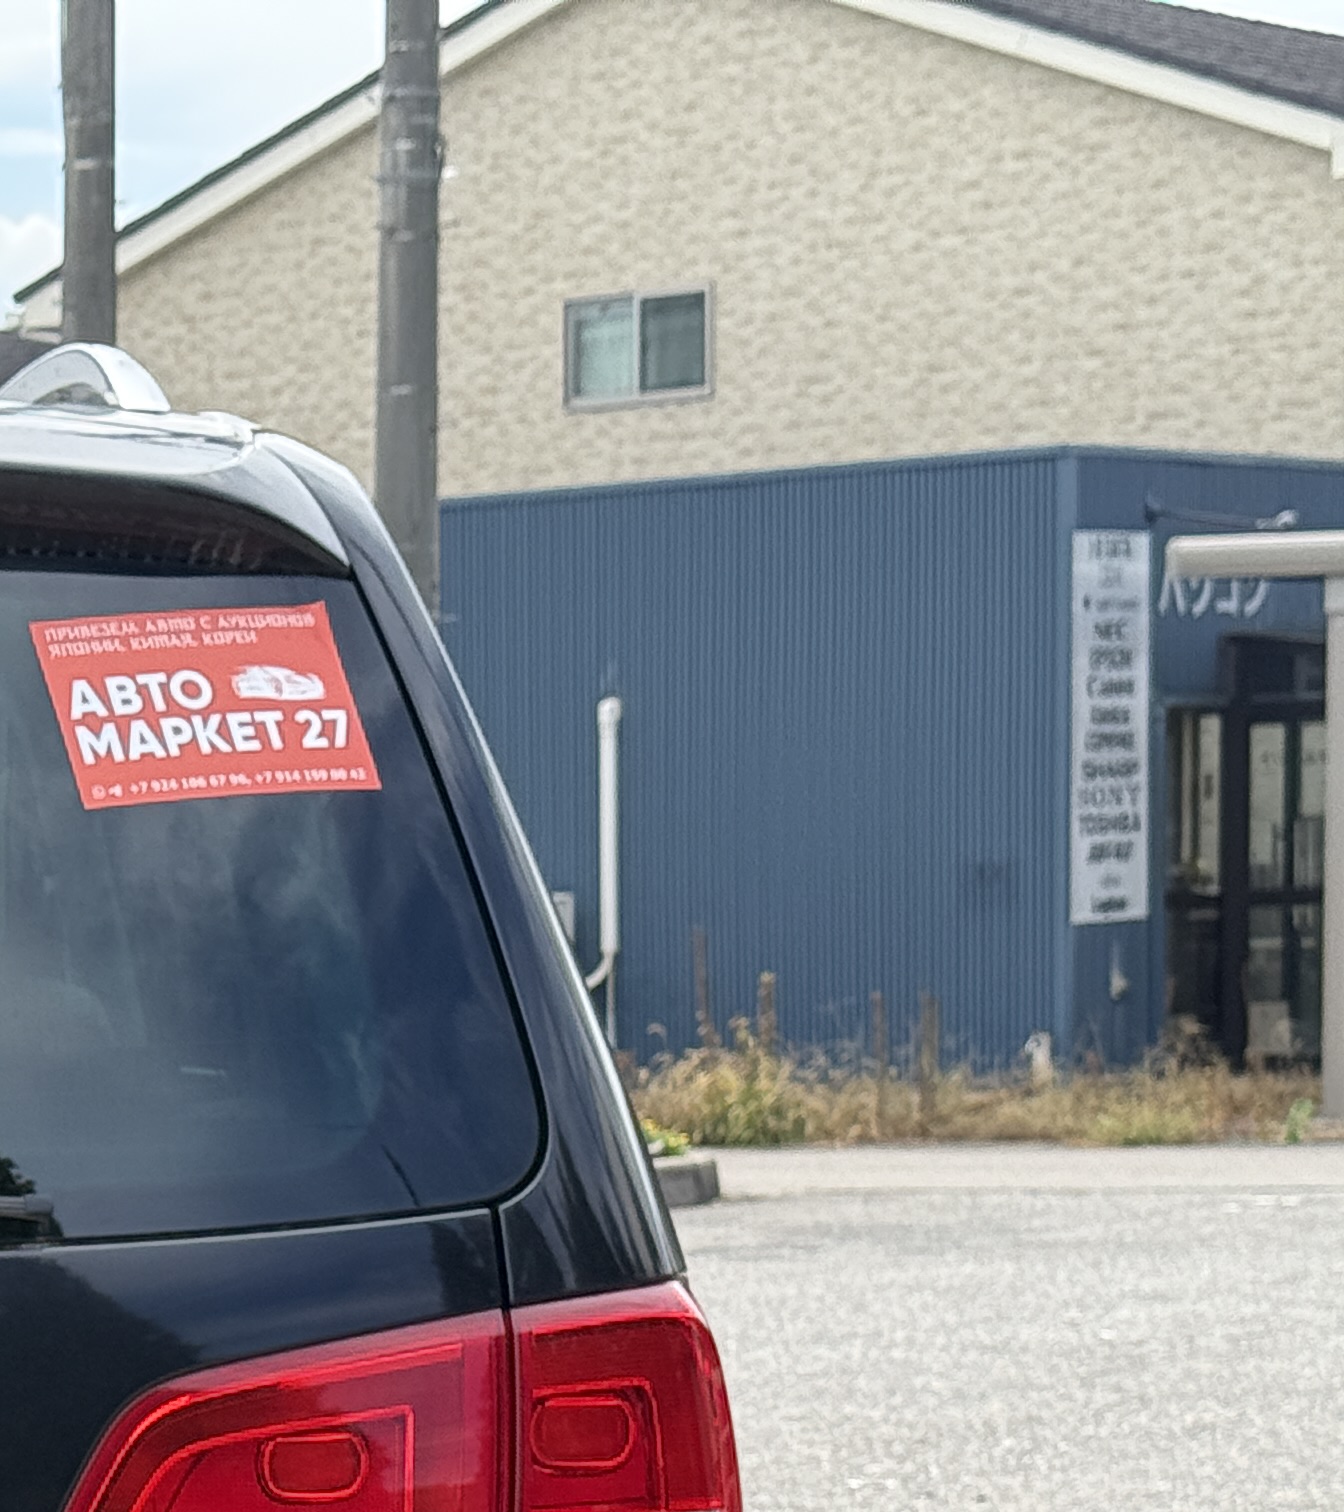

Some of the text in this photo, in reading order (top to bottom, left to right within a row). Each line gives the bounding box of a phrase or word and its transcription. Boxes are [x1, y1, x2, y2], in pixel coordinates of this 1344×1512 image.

[146, 615, 196, 635] АВТО
[200, 613, 212, 631] С
[217, 611, 316, 630] АУКЦИОНОВ
[202, 629, 258, 646] КОРЕИ
[69, 669, 214, 721] АВТО
[73, 708, 349, 766] МАРКЕТ 27
